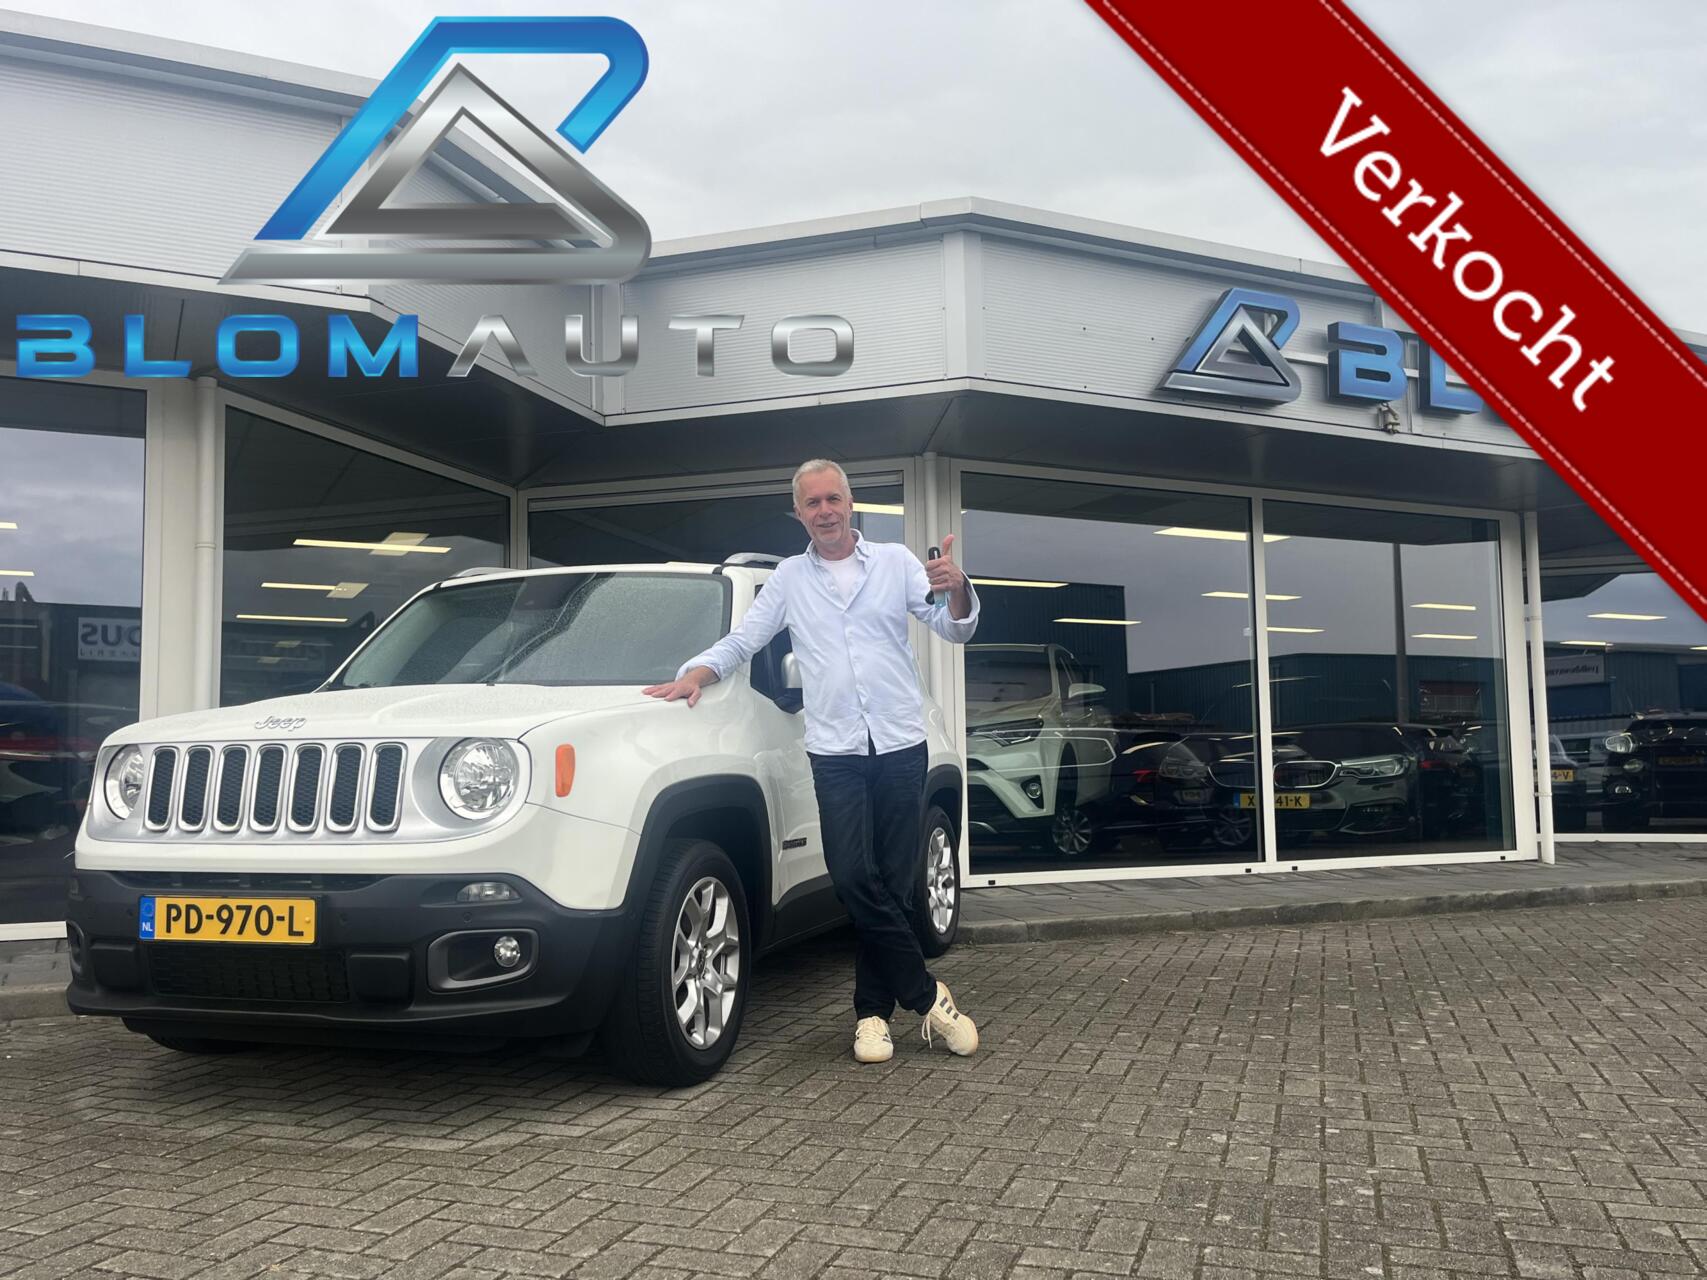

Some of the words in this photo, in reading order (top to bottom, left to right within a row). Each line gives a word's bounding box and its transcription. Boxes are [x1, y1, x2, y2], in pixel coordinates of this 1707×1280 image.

[1326, 320, 1484, 415] BL
[255, 715, 306, 732] Jeep
[142, 921, 153, 932] NL
[165, 903, 304, 937] PD-970-L
